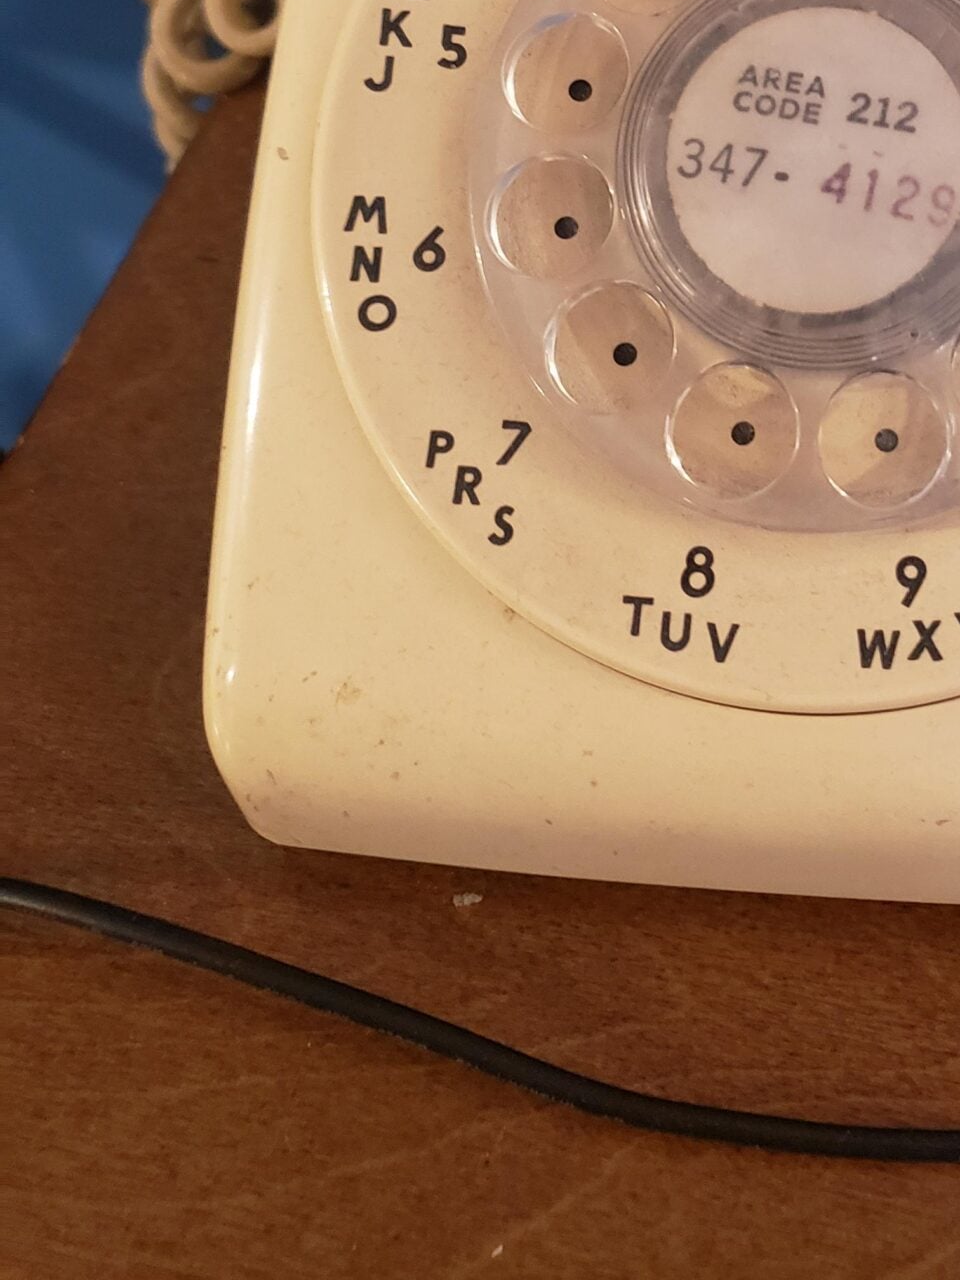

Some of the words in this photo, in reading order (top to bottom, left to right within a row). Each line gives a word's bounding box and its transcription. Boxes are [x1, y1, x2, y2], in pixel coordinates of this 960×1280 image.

[438, 25, 467, 69] 5
[738, 64, 825, 99] AREA
[733, 91, 822, 125] CODE
[847, 93, 918, 133] 212
[820, 162, 956, 227] 4129
[413, 227, 445, 272] 6
[496, 420, 532, 465] 7
[681, 546, 715, 598] 8
[896, 556, 927, 608] 9
[623, 595, 739, 663] TUV
